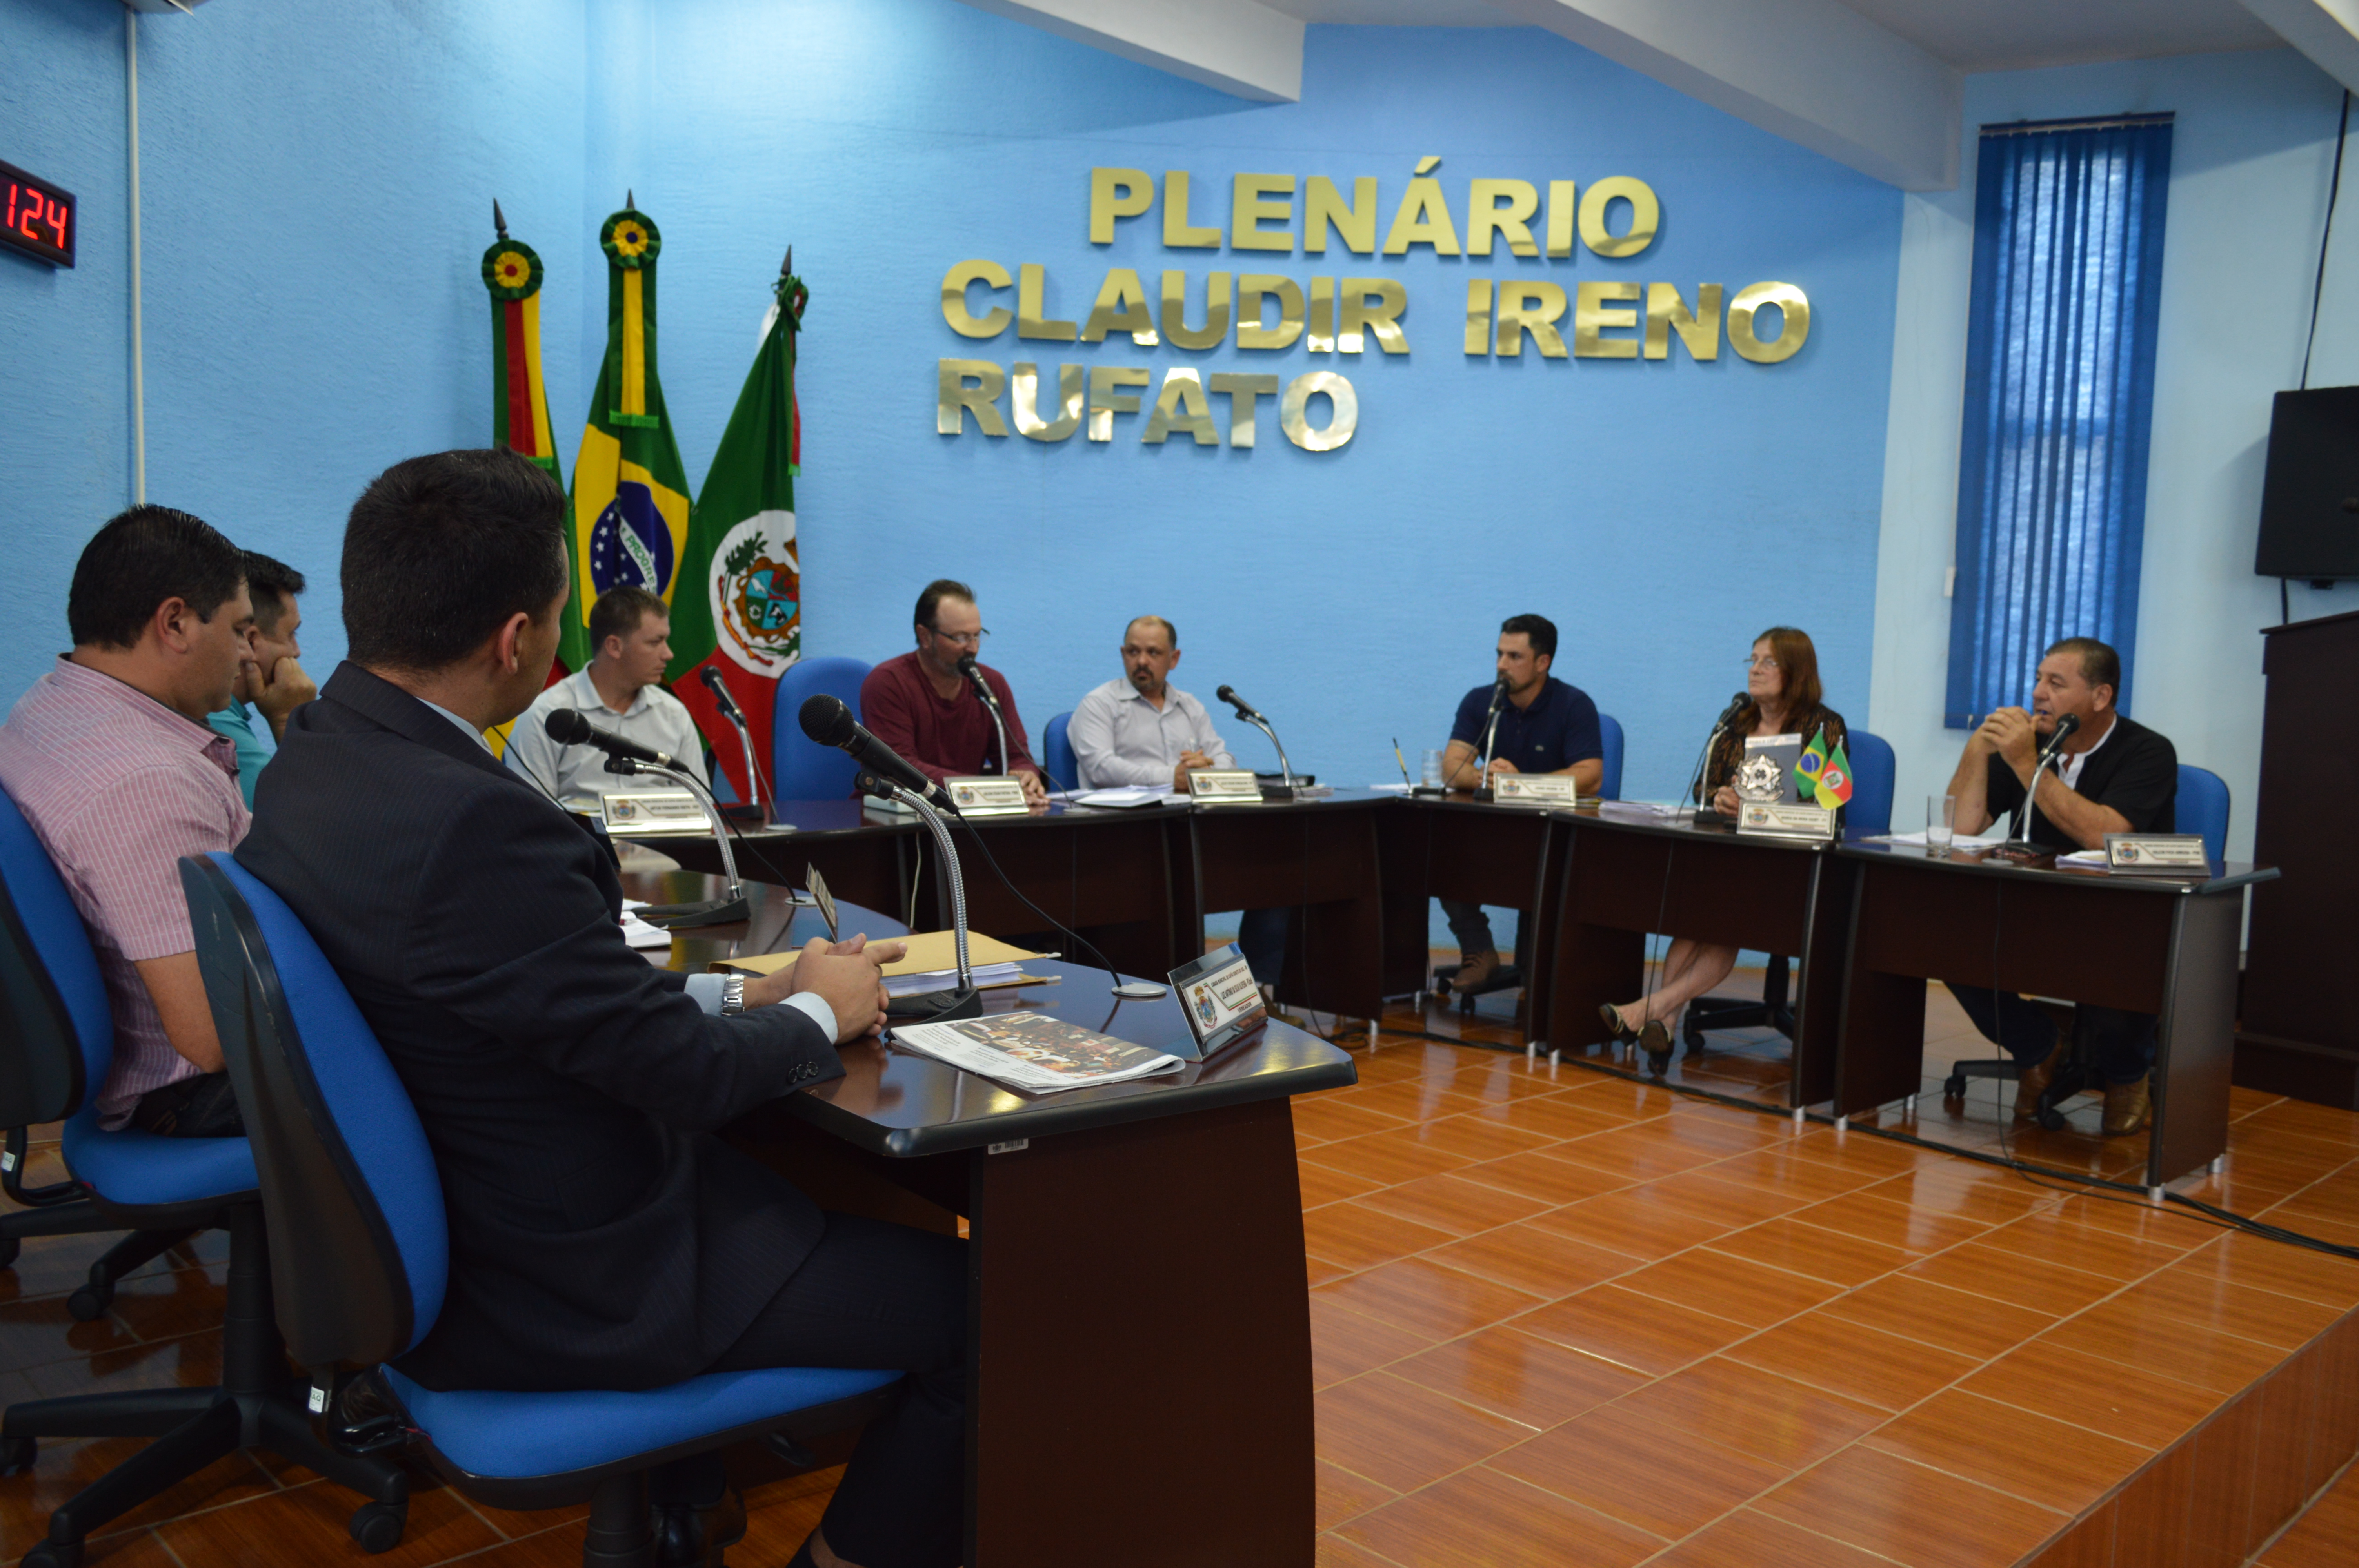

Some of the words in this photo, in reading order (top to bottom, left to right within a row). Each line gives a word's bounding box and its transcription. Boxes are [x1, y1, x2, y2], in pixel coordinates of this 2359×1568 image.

[1089, 156, 1660, 259] PLENÁRIO
[940, 258, 1410, 355] CLAUDIR
[1463, 280, 1812, 363] IRENO
[936, 357, 1359, 452] RUFATO
[1237, 1001, 1252, 1013] VEREADOR
[311, 1394, 321, 1402] AQ
